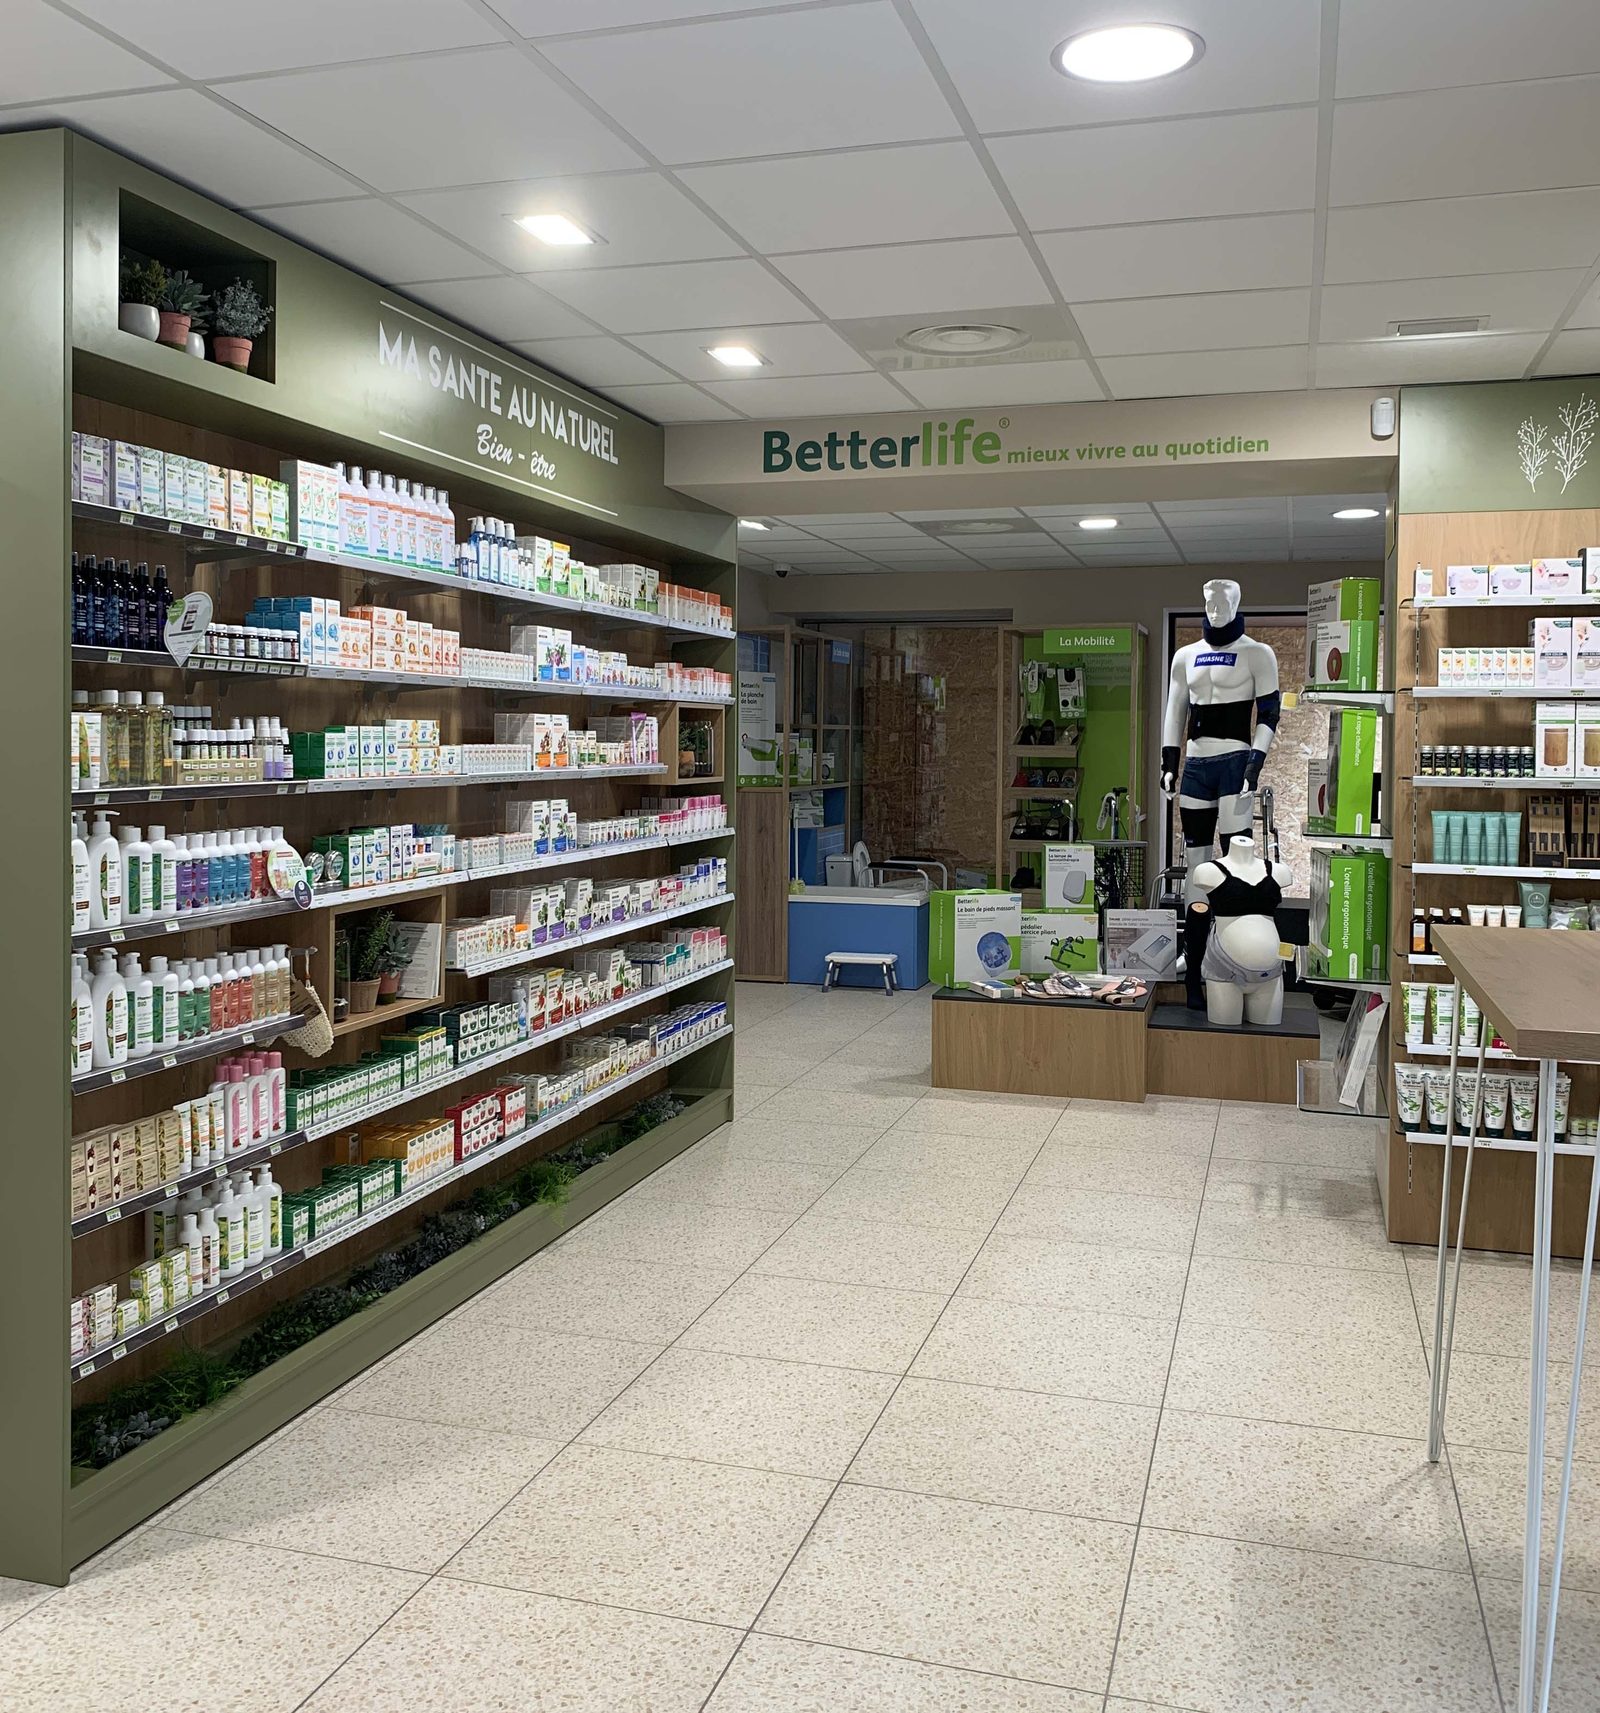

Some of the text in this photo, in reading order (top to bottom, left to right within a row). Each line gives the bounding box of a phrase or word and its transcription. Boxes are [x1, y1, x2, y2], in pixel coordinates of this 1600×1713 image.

[378, 320, 618, 465] MA SANTE AU NATUREL
[476, 423, 513, 466] Bien
[530, 451, 556, 480] être
[1007, 442, 1070, 464] mieux
[1074, 440, 1126, 460] vivre
[1132, 440, 1159, 458] au
[1165, 436, 1270, 461] quotidien
[1060, 636, 1115, 646] La Mobilité
[1342, 867, 1352, 950] L'oreiller ergonomique
[1366, 893, 1374, 940] ergonomique
